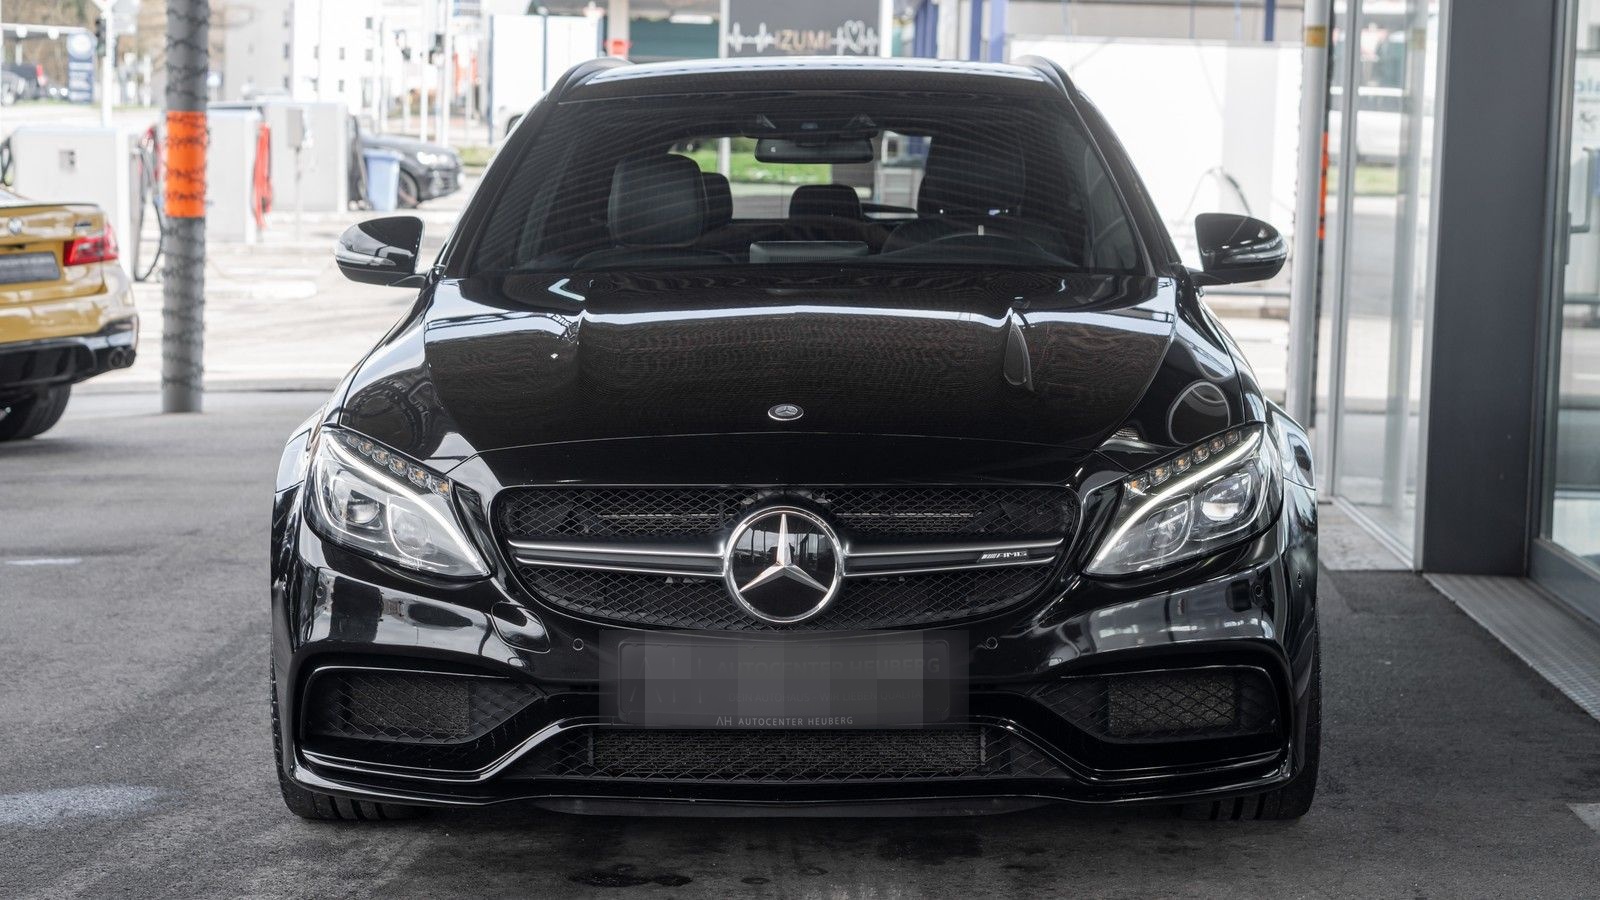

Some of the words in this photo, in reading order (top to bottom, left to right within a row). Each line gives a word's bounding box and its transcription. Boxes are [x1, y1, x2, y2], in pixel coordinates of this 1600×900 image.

[775, 29, 831, 51] IZUMI
[996, 550, 1027, 558] AMG
[849, 657, 940, 674] HEUBERG
[738, 716, 804, 727] AUTOCENTER
[808, 715, 853, 726] HEUBERG
